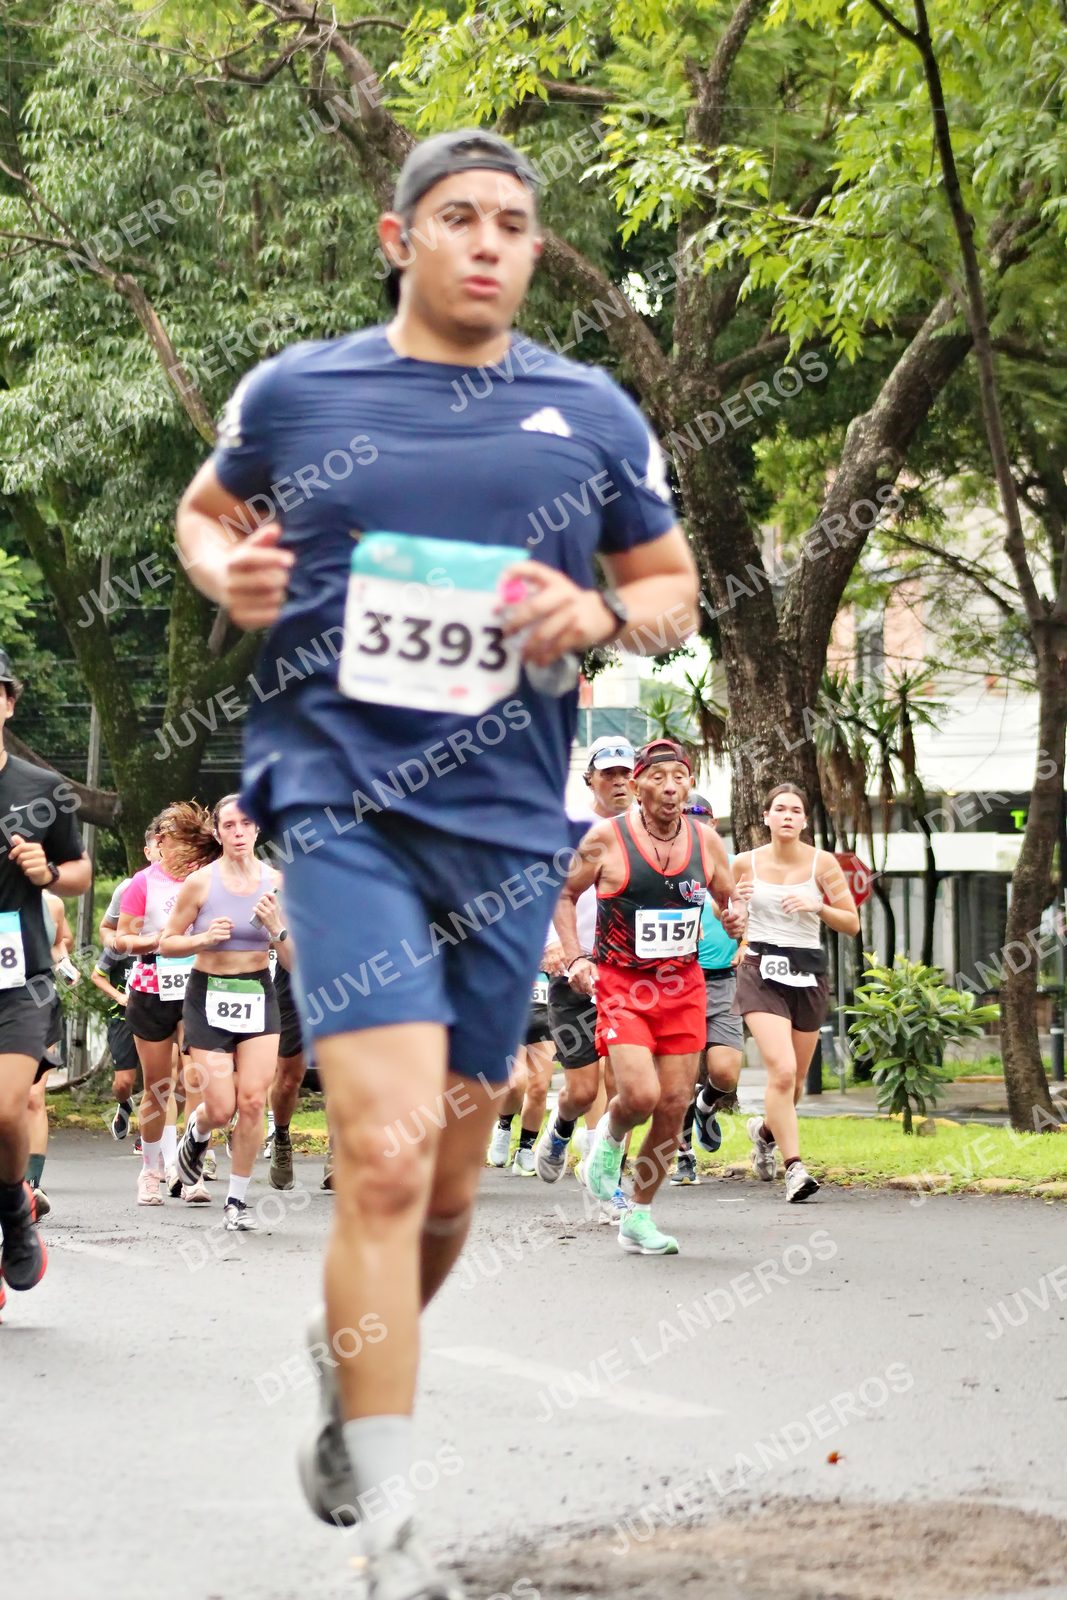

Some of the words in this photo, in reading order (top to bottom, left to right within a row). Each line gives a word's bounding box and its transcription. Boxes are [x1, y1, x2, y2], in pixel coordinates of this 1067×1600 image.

[358, 610, 508, 671] 3393
[640, 920, 696, 942] 5157
[765, 961, 810, 977] 68
[217, 1001, 252, 1019] 821
